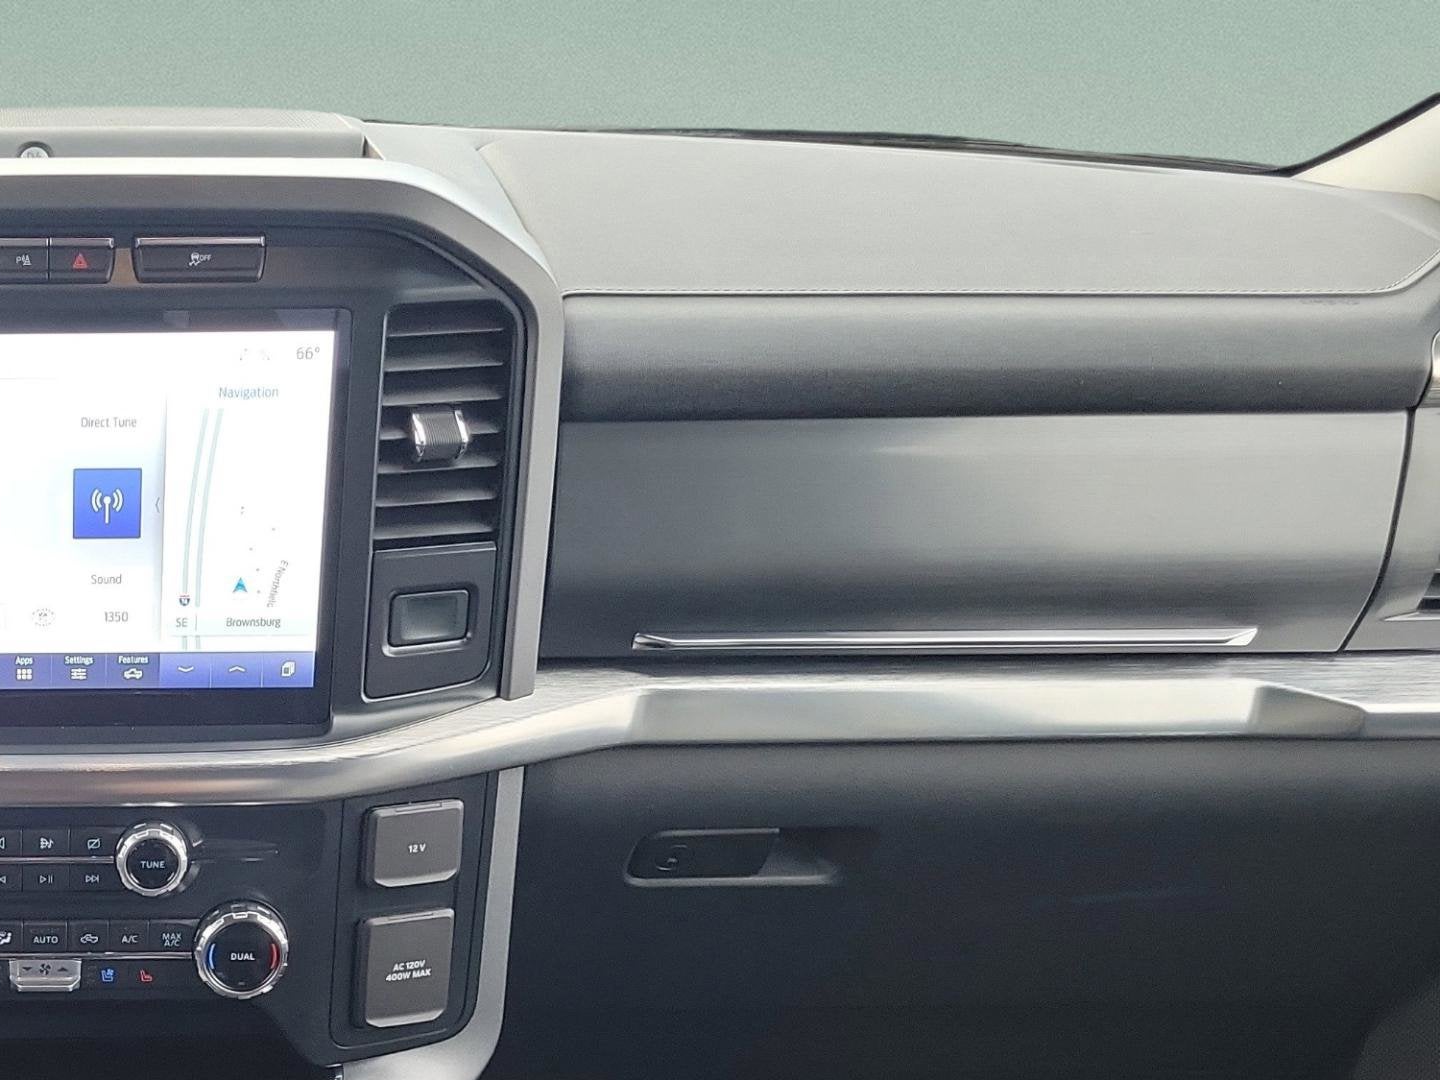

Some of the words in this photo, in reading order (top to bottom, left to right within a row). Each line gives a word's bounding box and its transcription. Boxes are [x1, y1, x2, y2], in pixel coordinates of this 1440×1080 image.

[218, 386, 279, 399] Navigation
[80, 416, 109, 428] Direct
[113, 416, 137, 428] Tune
[91, 574, 122, 585] Sound
[103, 611, 129, 622] 1350
[176, 617, 188, 628] SE
[225, 616, 281, 629] Brownsburg
[15, 656, 34, 669] Apps
[64, 655, 94, 668] Settings
[118, 655, 149, 666] Features
[408, 844, 421, 853] 12
[420, 843, 426, 852] V
[140, 860, 166, 869] TUNE
[33, 935, 59, 944] AUTO
[121, 935, 139, 943] A/C
[162, 933, 182, 941] MAX
[164, 939, 180, 948] A/C
[230, 952, 255, 962] DUAL
[393, 962, 405, 971] AC
[406, 959, 426, 970] 120V
[385, 972, 411, 982] 400W
[412, 968, 432, 979] MAX
